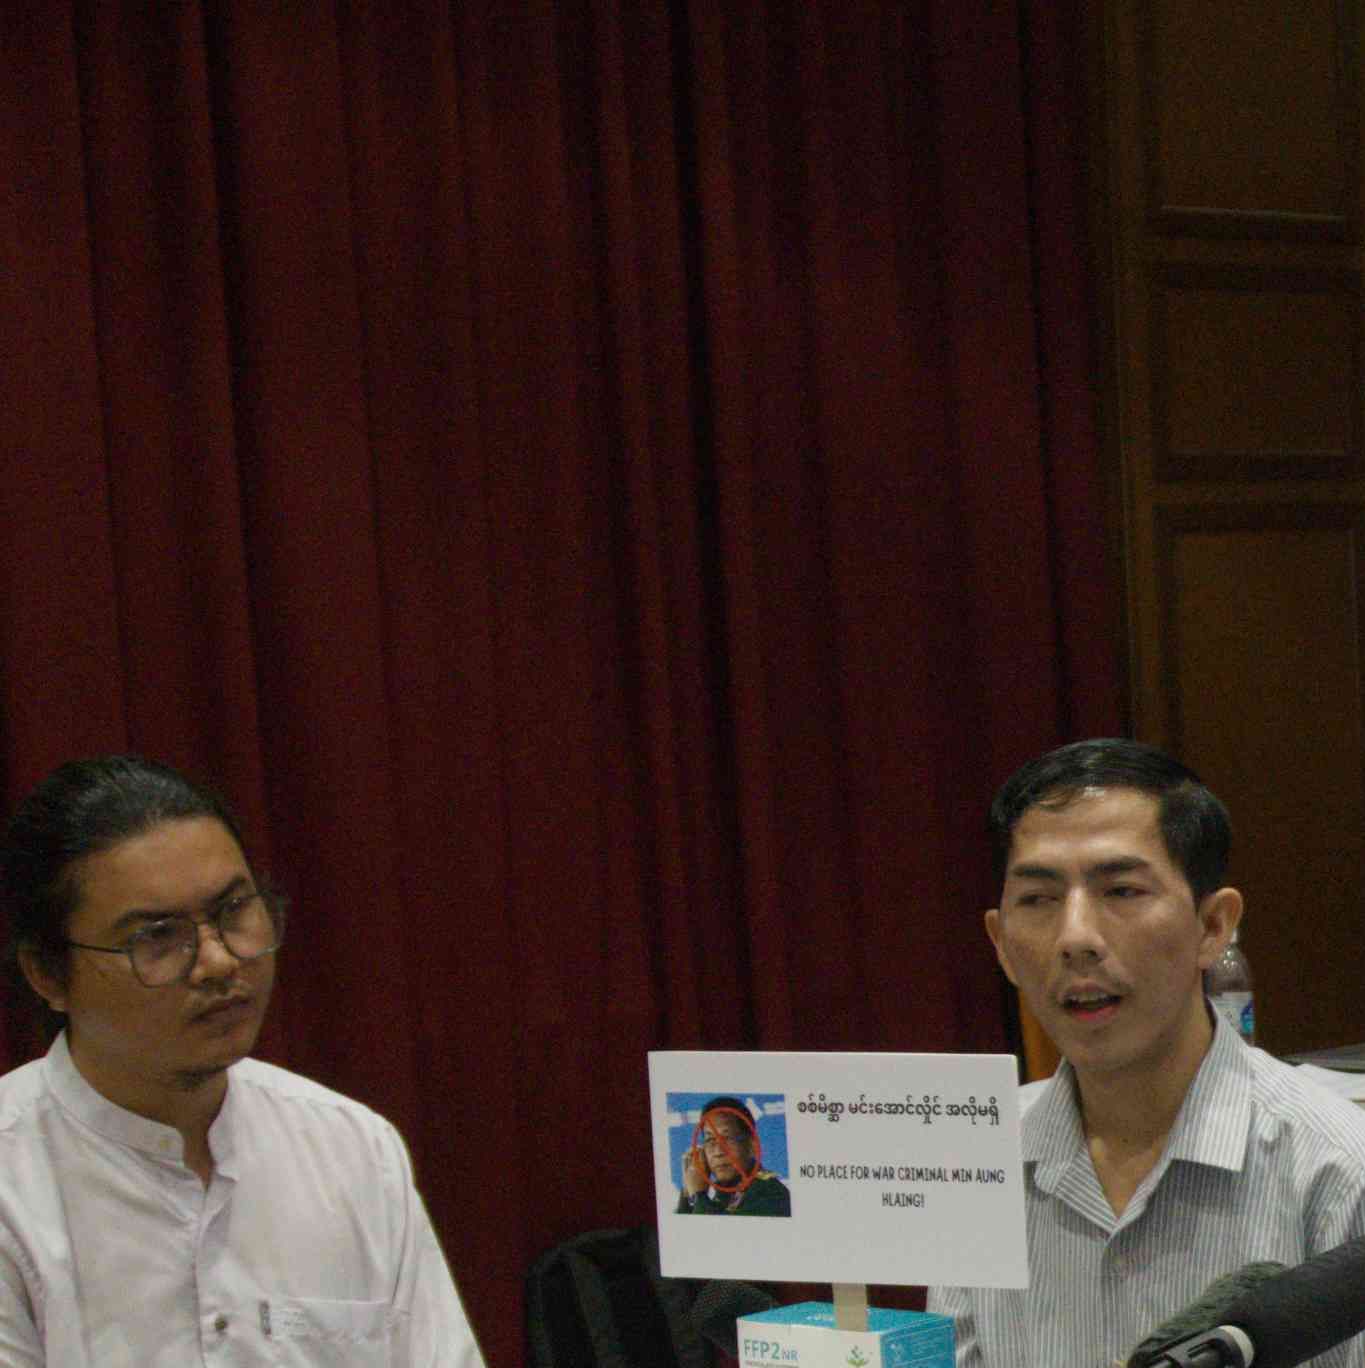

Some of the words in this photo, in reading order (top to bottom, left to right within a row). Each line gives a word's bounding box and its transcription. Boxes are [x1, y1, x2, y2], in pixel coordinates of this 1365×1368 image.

[799, 1164, 816, 1179] NO
[816, 1164, 849, 1180] PLACE
[850, 1165, 870, 1181] FOR
[871, 1166, 895, 1181] WAR
[897, 1166, 949, 1183] CRIMINAL
[951, 1167, 973, 1183] MIN
[975, 1167, 1005, 1184] AUNG
[881, 1192, 925, 1208] HLAING!
